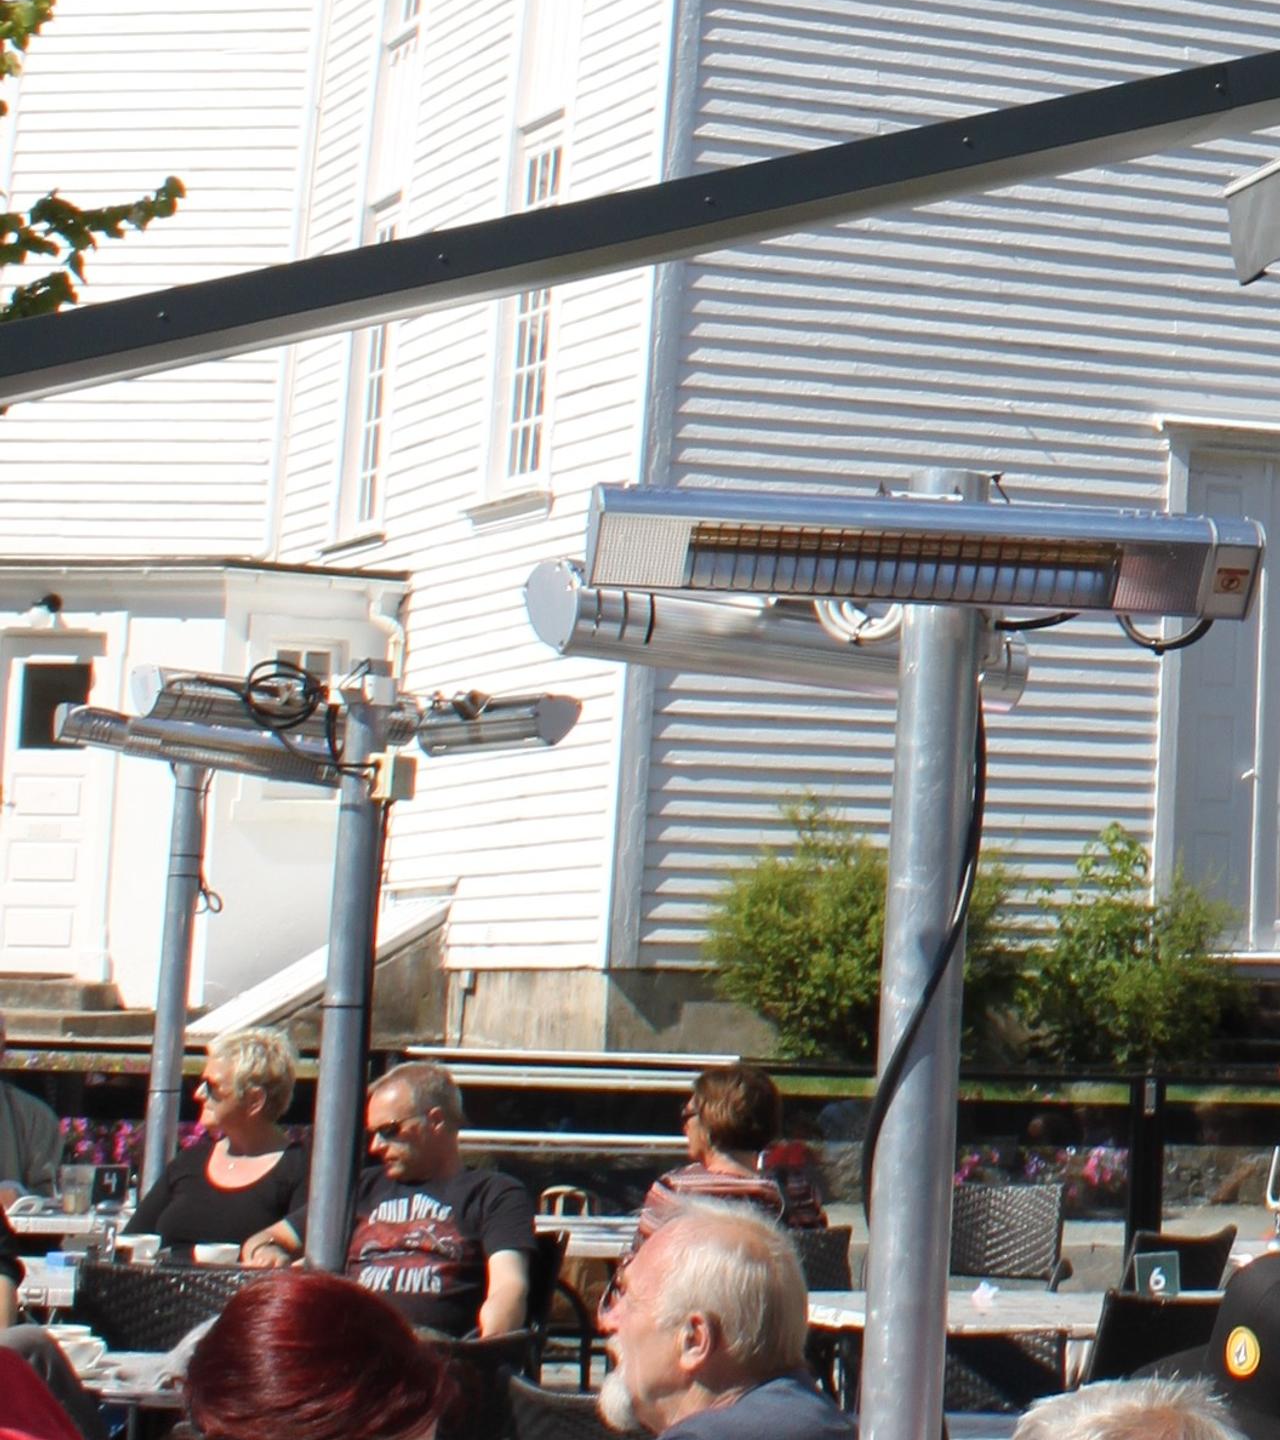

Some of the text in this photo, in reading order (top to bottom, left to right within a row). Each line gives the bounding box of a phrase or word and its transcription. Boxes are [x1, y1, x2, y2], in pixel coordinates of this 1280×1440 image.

[103, 1172, 118, 1193] 4
[358, 1264, 442, 1293] SAVE LIVES
[1149, 1266, 1166, 1291] 6
